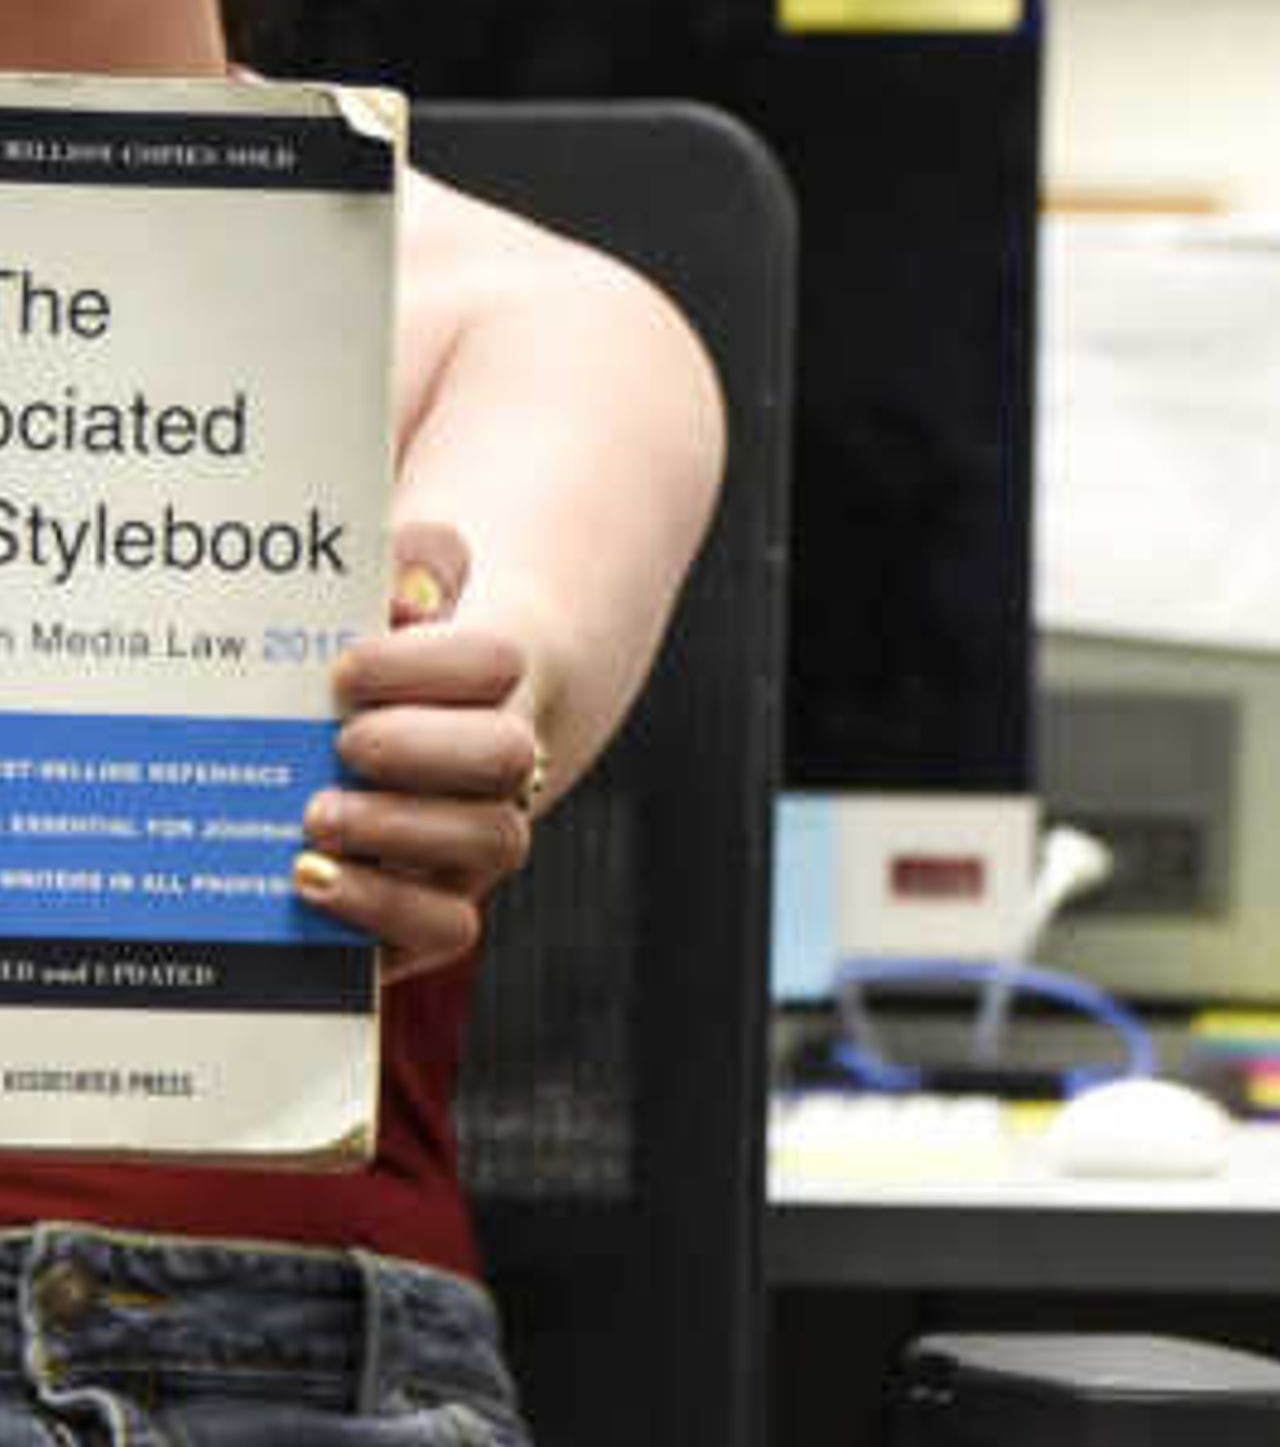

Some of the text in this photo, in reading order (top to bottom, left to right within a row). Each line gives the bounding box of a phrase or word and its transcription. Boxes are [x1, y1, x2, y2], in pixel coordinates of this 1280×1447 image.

[3, 138, 112, 164] MILLION
[122, 140, 217, 167] COPIES
[32, 620, 149, 658] Media
[166, 620, 247, 660] Law
[40, 961, 87, 985] and
[93, 961, 217, 988] UPDATED
[128, 1071, 194, 1096] PRESS
